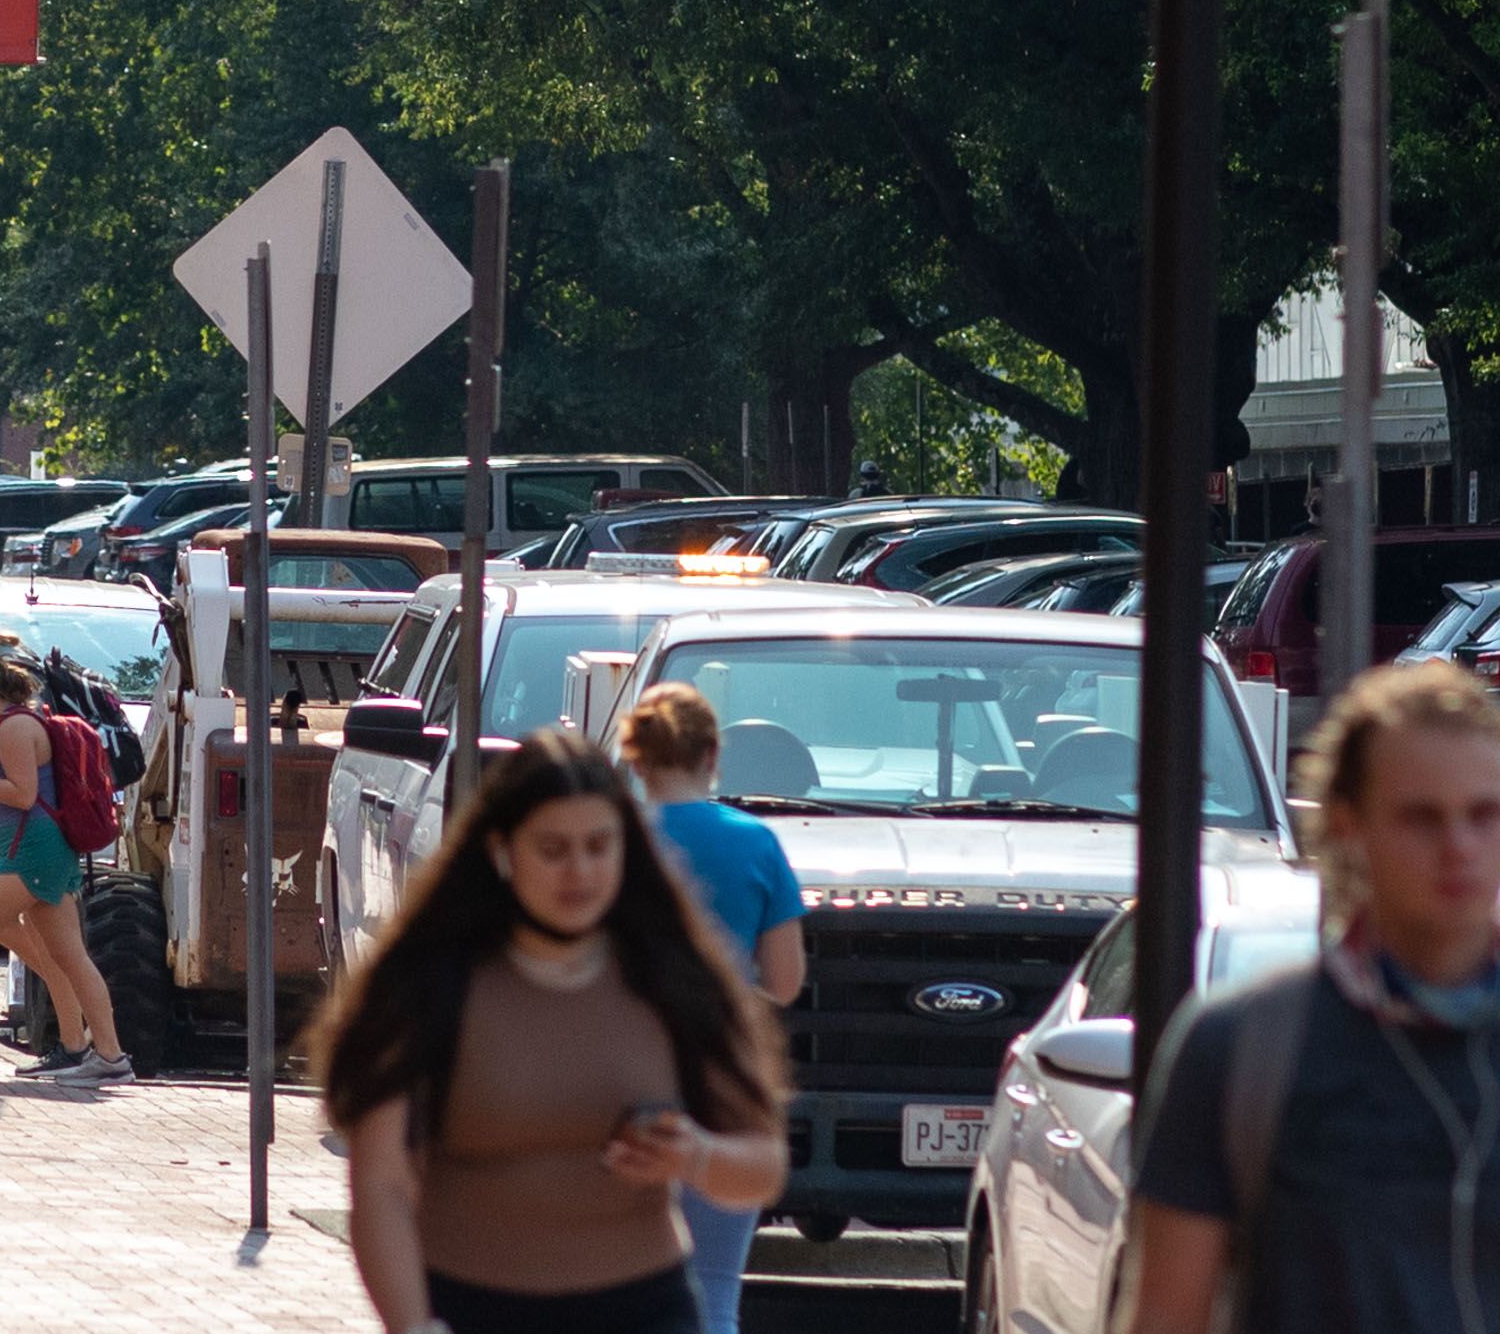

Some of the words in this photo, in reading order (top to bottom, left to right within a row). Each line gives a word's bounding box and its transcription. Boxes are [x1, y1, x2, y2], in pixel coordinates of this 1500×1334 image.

[800, 889, 965, 907] SUPER
[997, 891, 1136, 911] DUTY
[934, 988, 984, 1011] Ford
[917, 1121, 990, 1152] PJ-37
